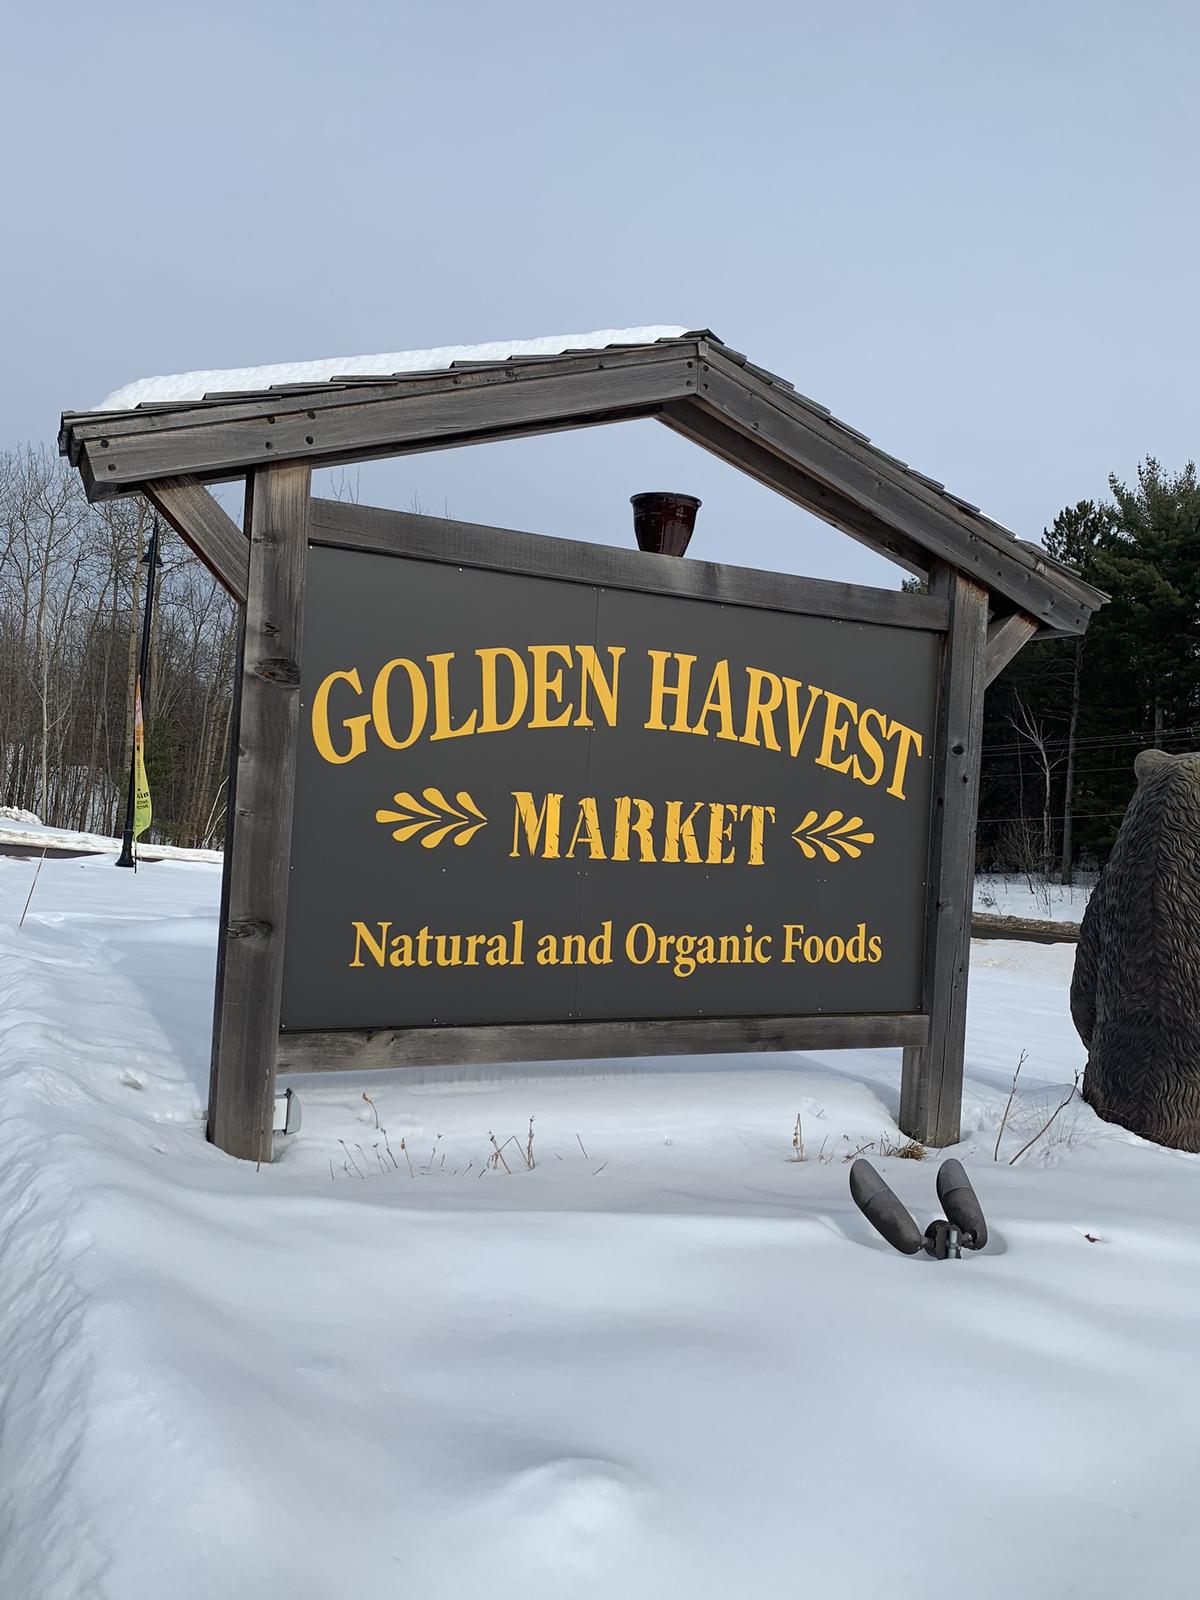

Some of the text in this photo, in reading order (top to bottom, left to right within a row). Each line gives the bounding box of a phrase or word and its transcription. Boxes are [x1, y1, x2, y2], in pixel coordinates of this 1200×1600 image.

[312, 644, 923, 801] GOLDEN HARVEST
[510, 791, 777, 866] MARKET
[349, 920, 883, 978] Natural and Organic Foods
